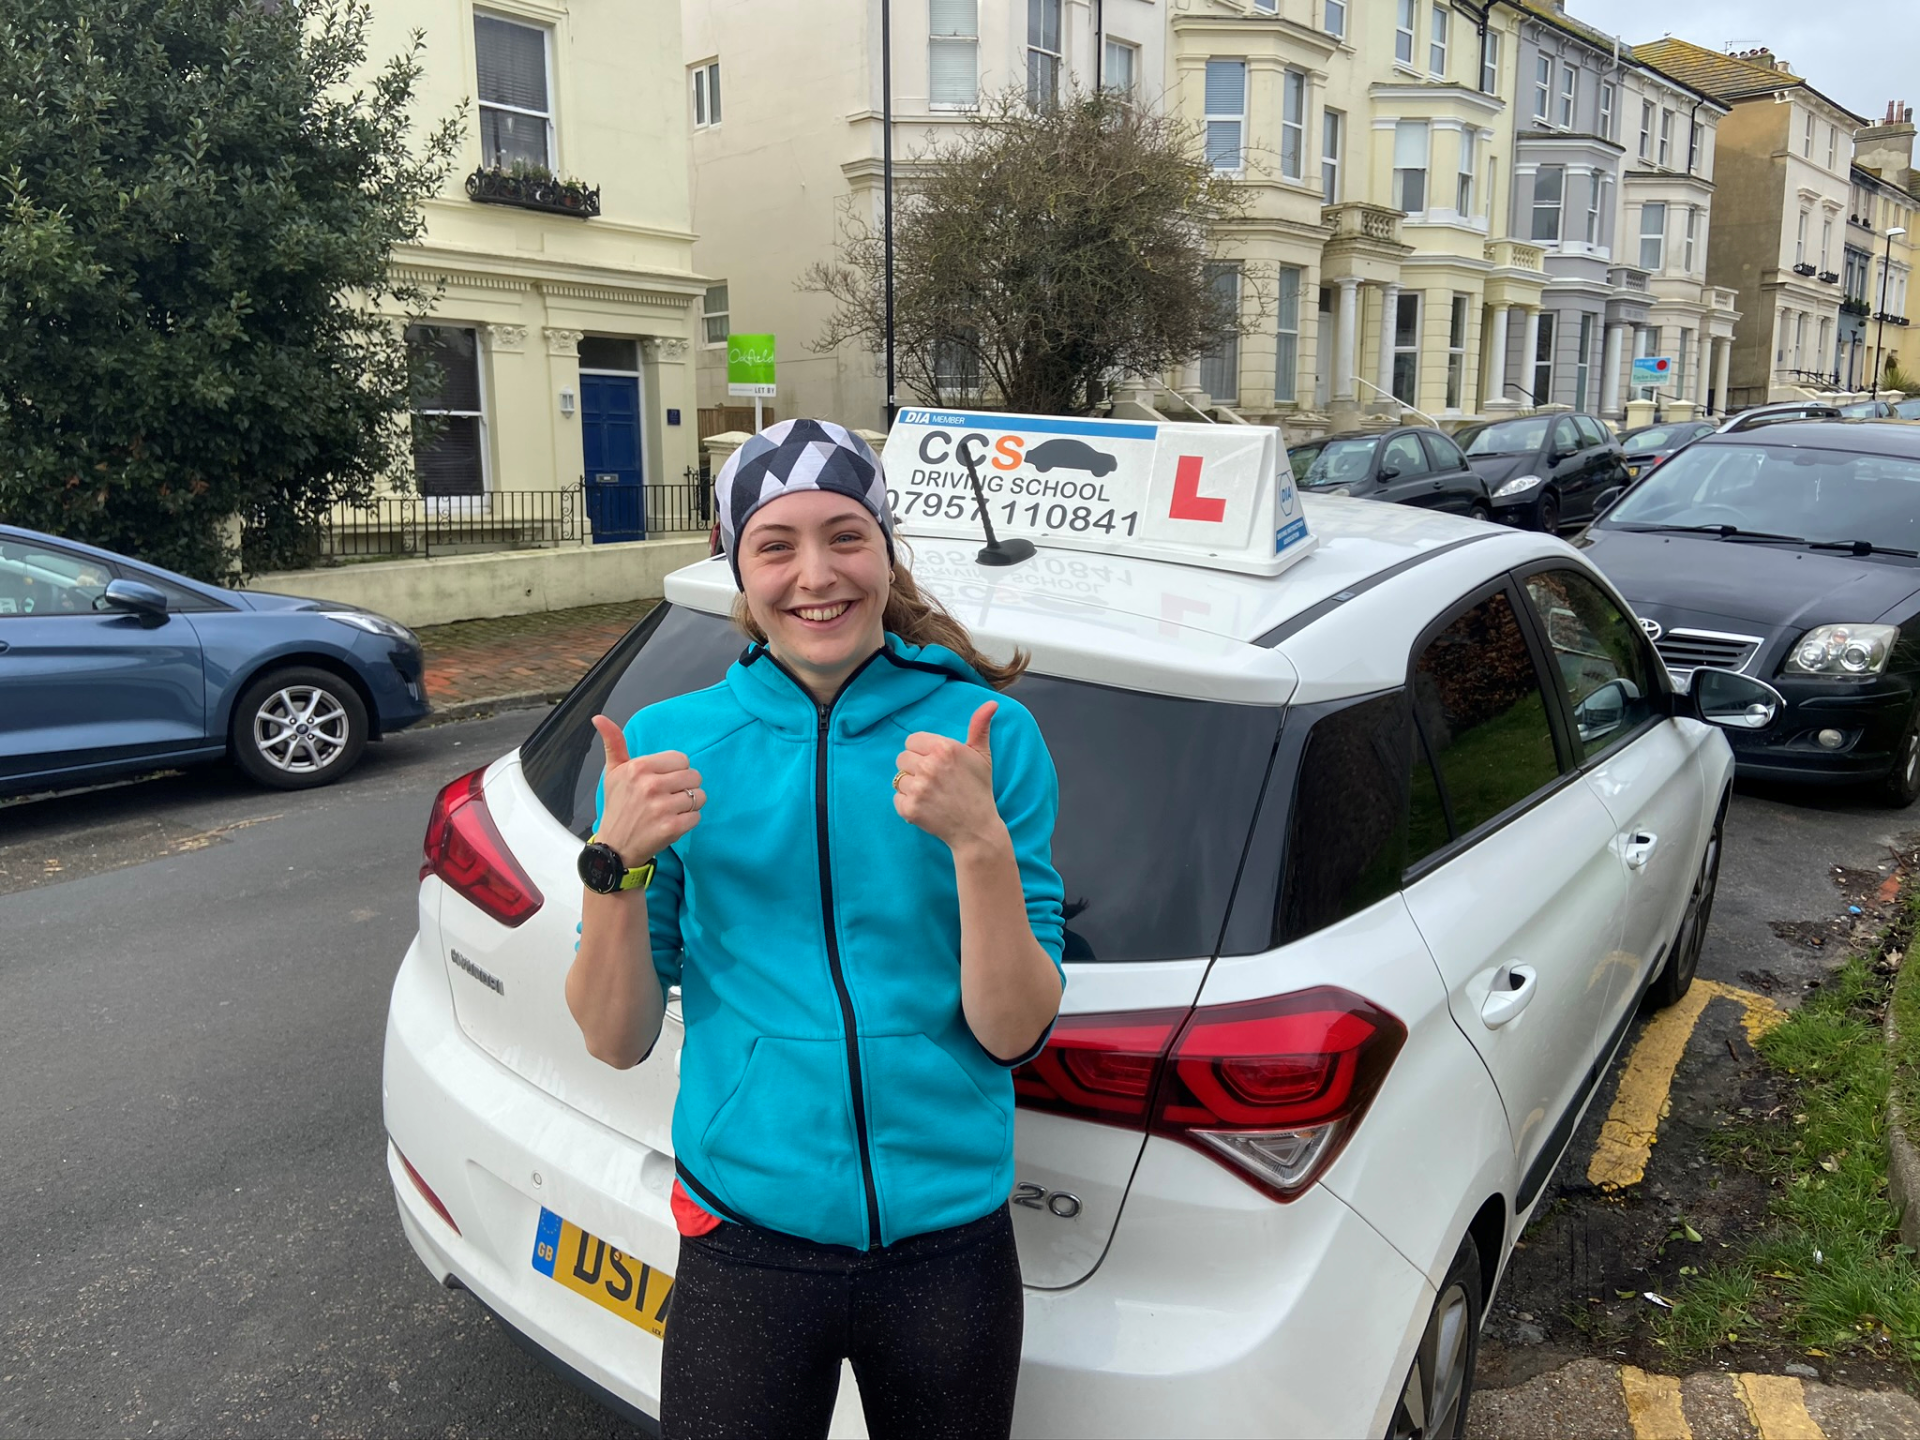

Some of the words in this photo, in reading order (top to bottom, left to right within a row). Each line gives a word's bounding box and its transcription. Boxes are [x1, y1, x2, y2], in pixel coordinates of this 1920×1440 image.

[905, 411, 931, 425] DIA
[932, 415, 966, 425] MEMBER
[918, 430, 1025, 471] CCS
[910, 469, 1004, 493] DRIVING
[1010, 477, 1110, 502] SCHOOL
[1168, 455, 1227, 523] L
[1001, 500, 1138, 537] 110841
[537, 1241, 554, 1262] GB
